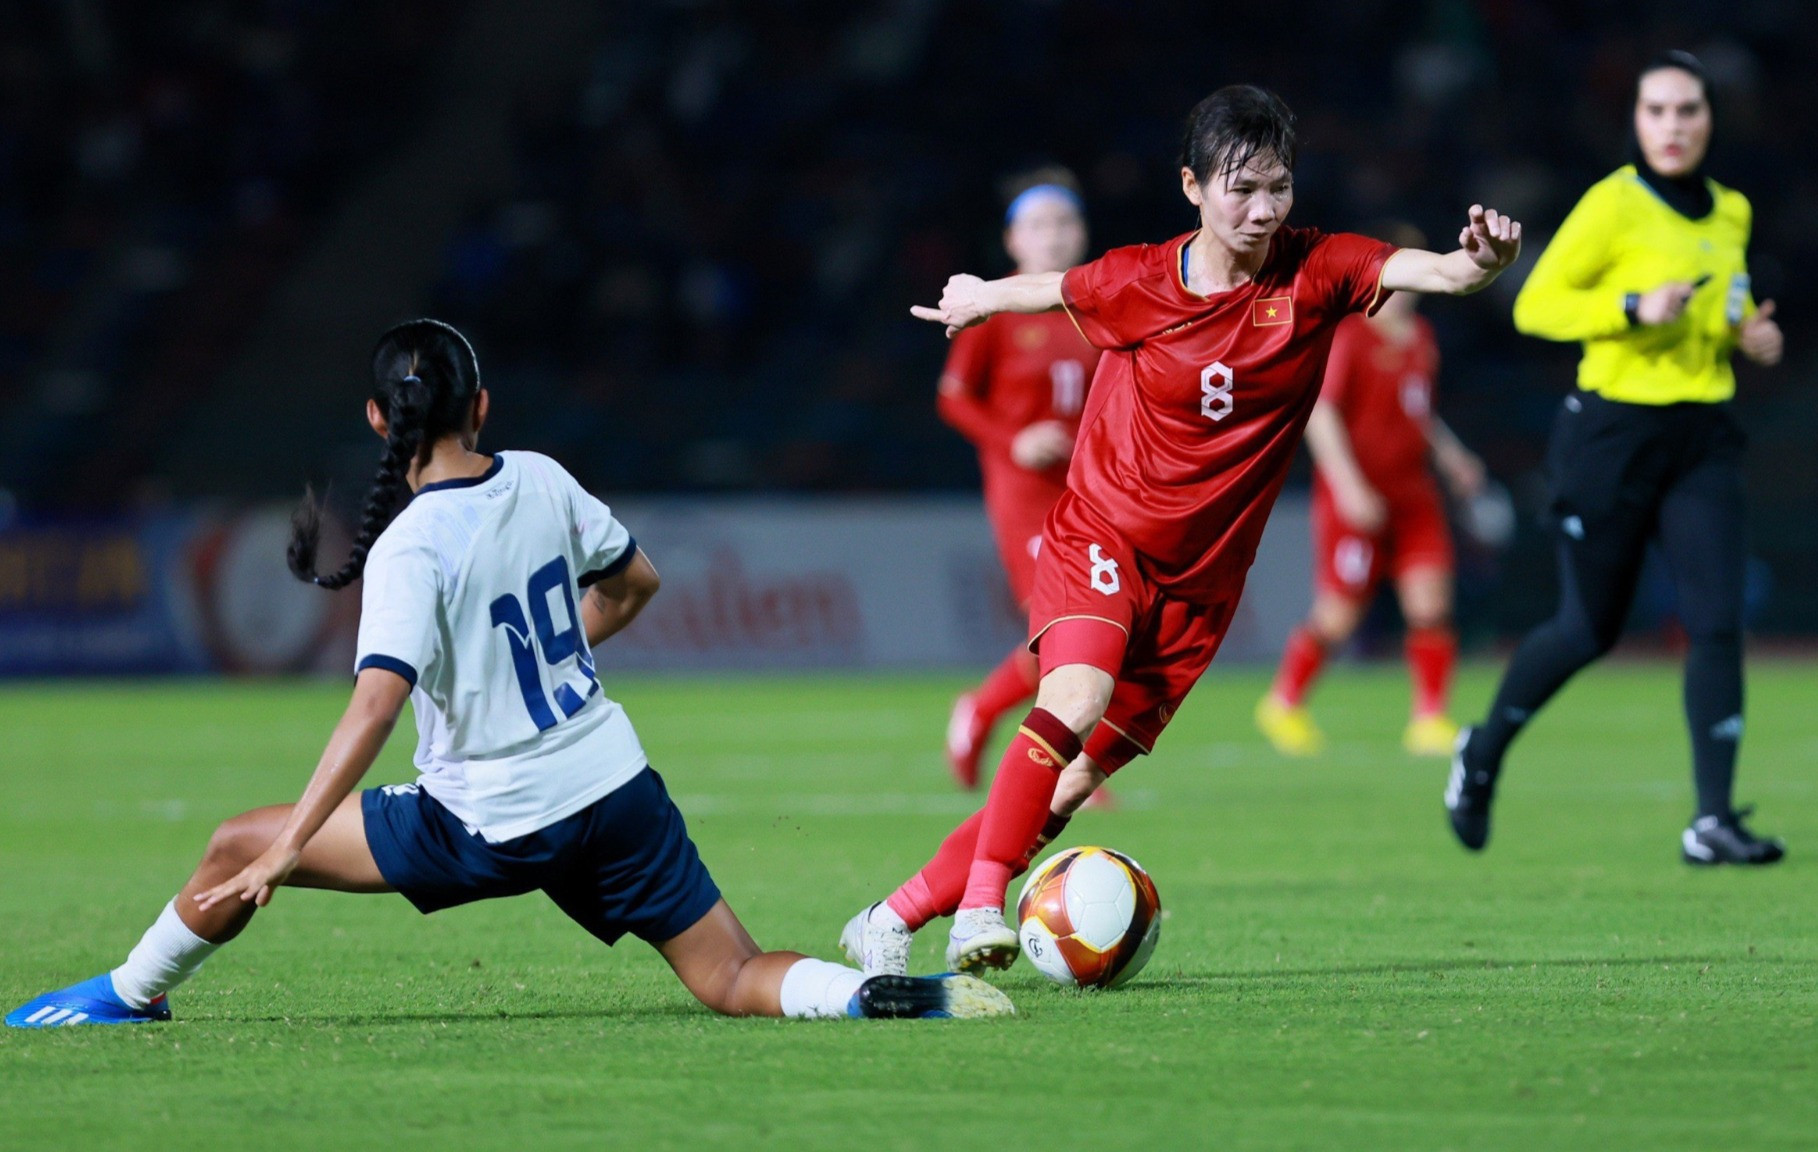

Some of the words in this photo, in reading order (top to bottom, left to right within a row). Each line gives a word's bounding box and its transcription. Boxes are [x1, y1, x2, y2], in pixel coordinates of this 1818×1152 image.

[1200, 360, 1234, 422] 8
[1088, 542, 1121, 596] 8
[489, 554, 600, 732] 19
